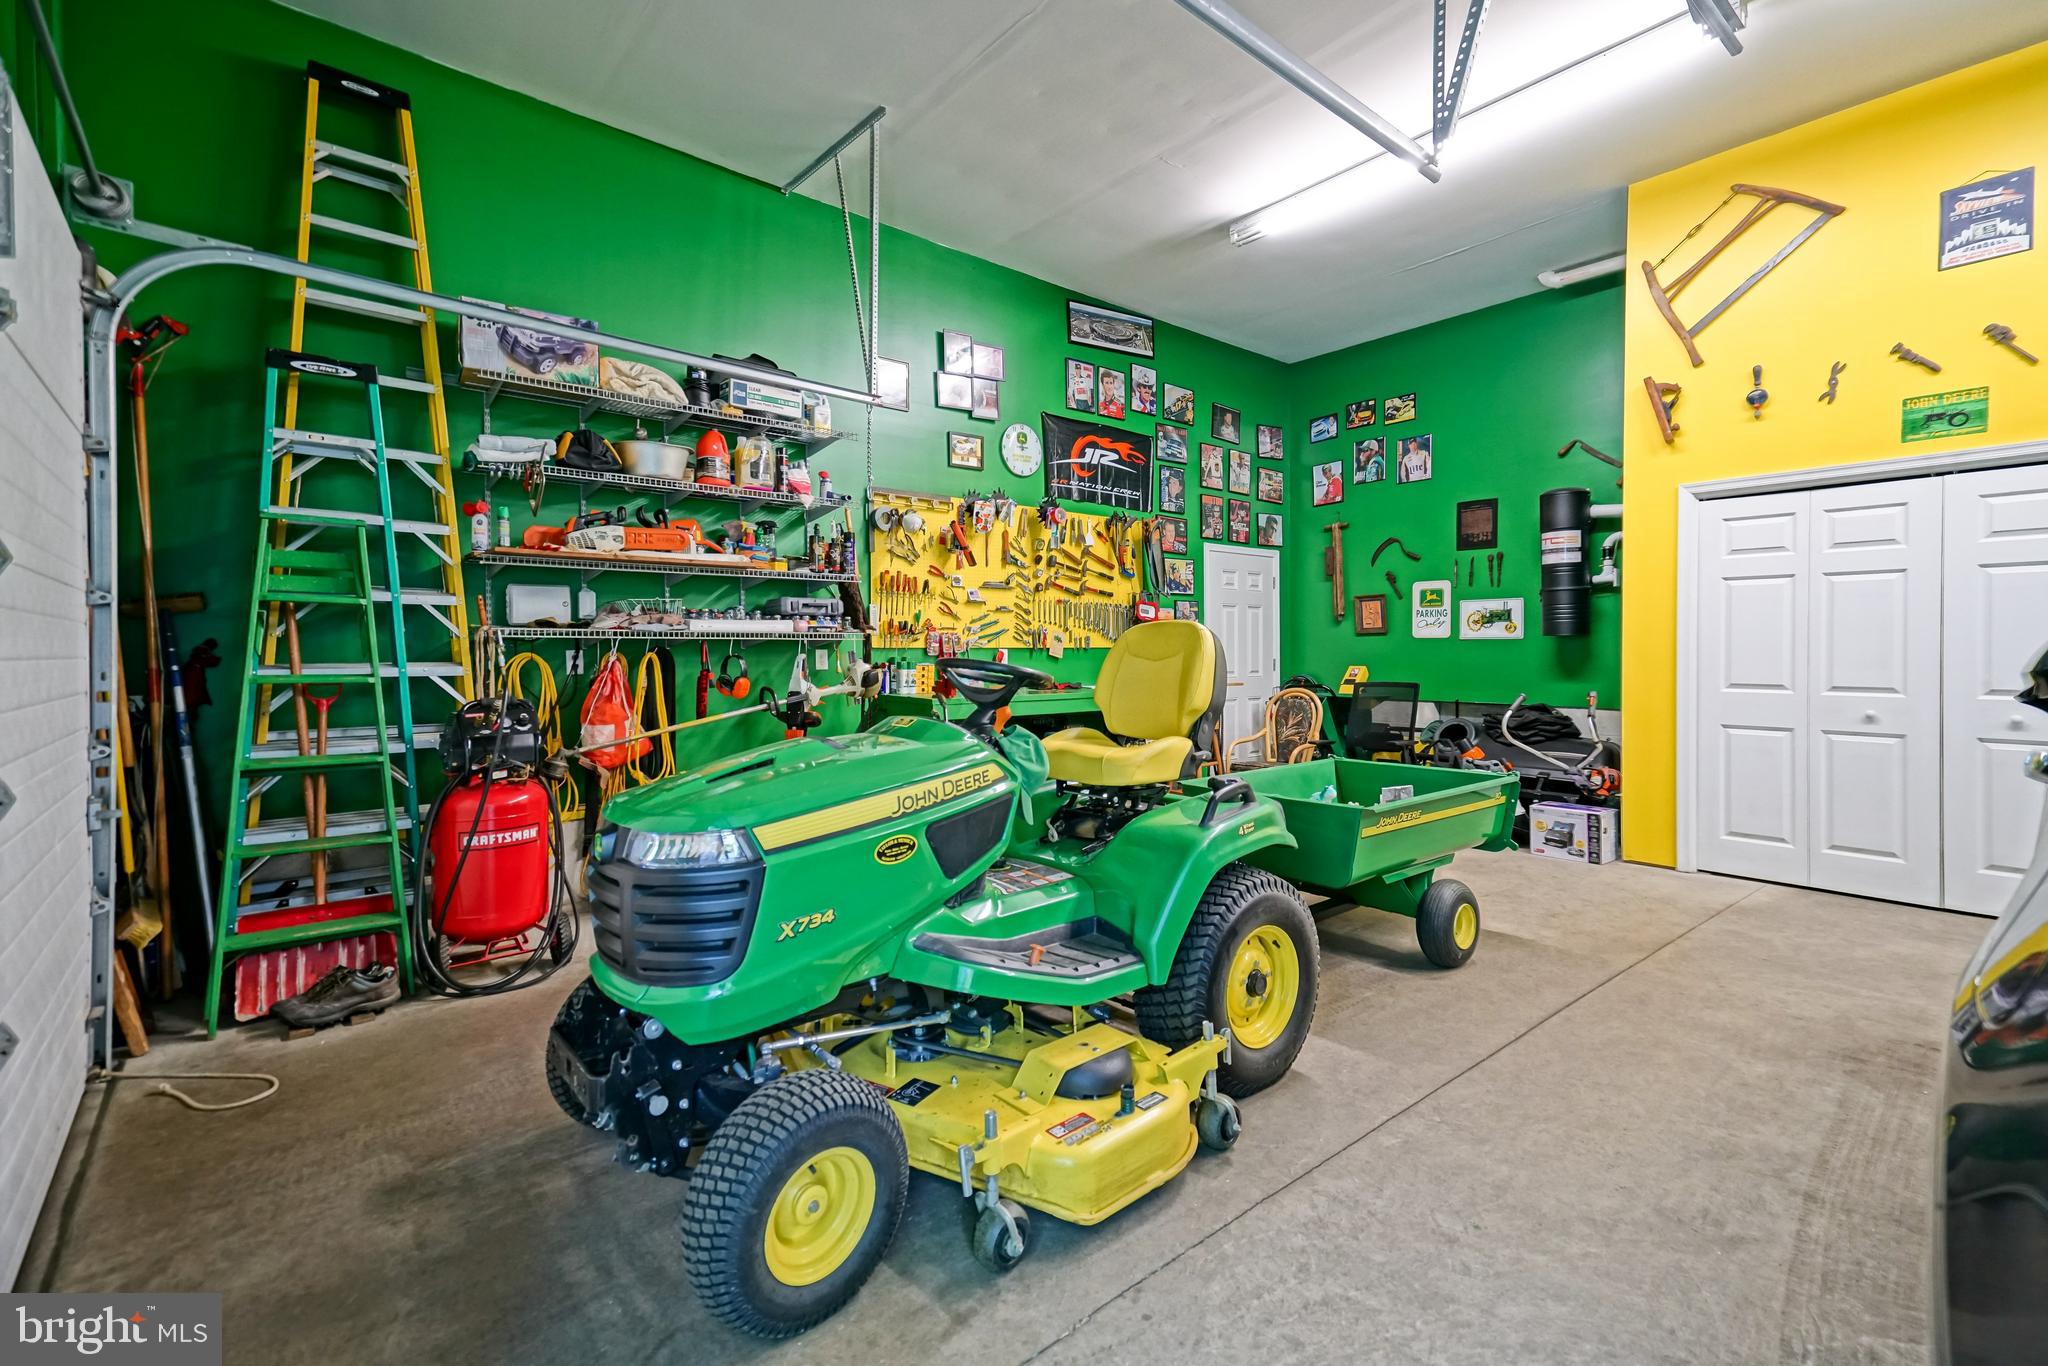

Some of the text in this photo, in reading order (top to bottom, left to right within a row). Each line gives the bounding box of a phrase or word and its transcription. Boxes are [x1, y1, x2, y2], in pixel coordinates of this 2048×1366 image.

[1069, 480, 1112, 491] NATION
[1113, 487, 1141, 496] CREW
[1416, 608, 1448, 618] PARKING
[892, 769, 991, 815] JOHN DEERE
[1376, 810, 1422, 828] JOHN DEERE
[463, 827, 539, 847] CRAFTSMAN
[777, 908, 836, 942] X734
